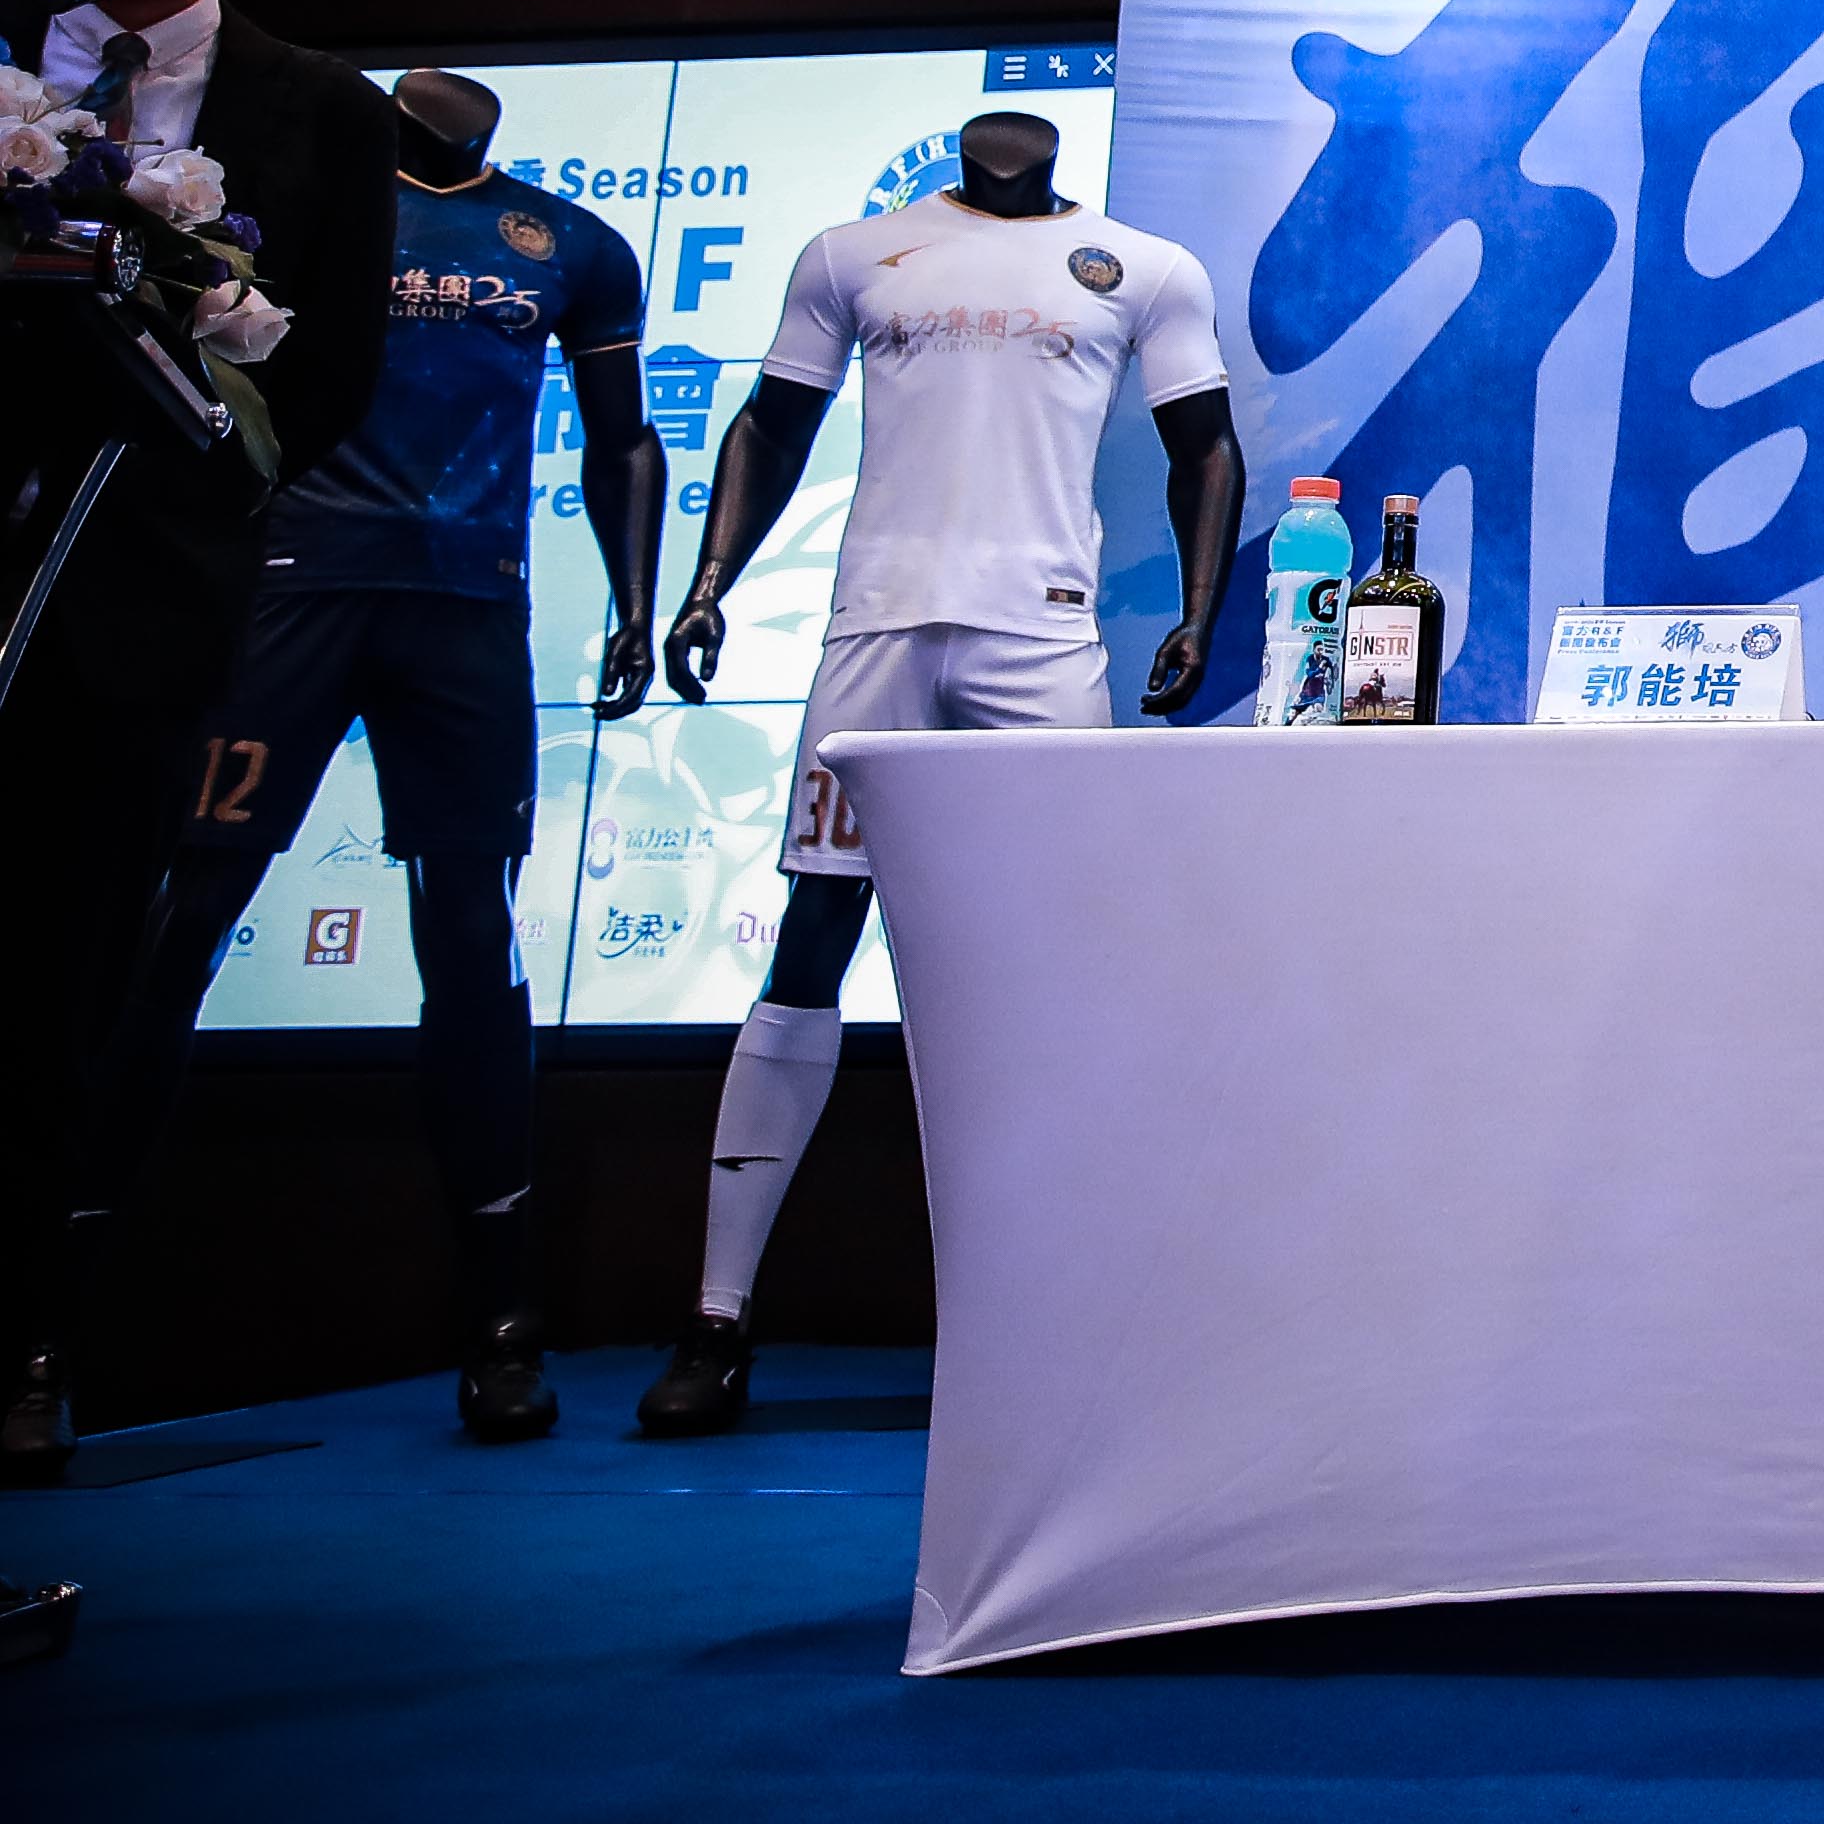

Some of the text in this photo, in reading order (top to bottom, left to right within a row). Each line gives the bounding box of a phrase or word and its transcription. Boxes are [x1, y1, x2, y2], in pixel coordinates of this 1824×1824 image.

[557, 158, 749, 200] Season
[390, 269, 472, 307] 集團
[674, 227, 745, 313] F
[1308, 578, 1343, 623] G
[1581, 663, 1742, 707] 郭能培
[195, 738, 268, 822] 12
